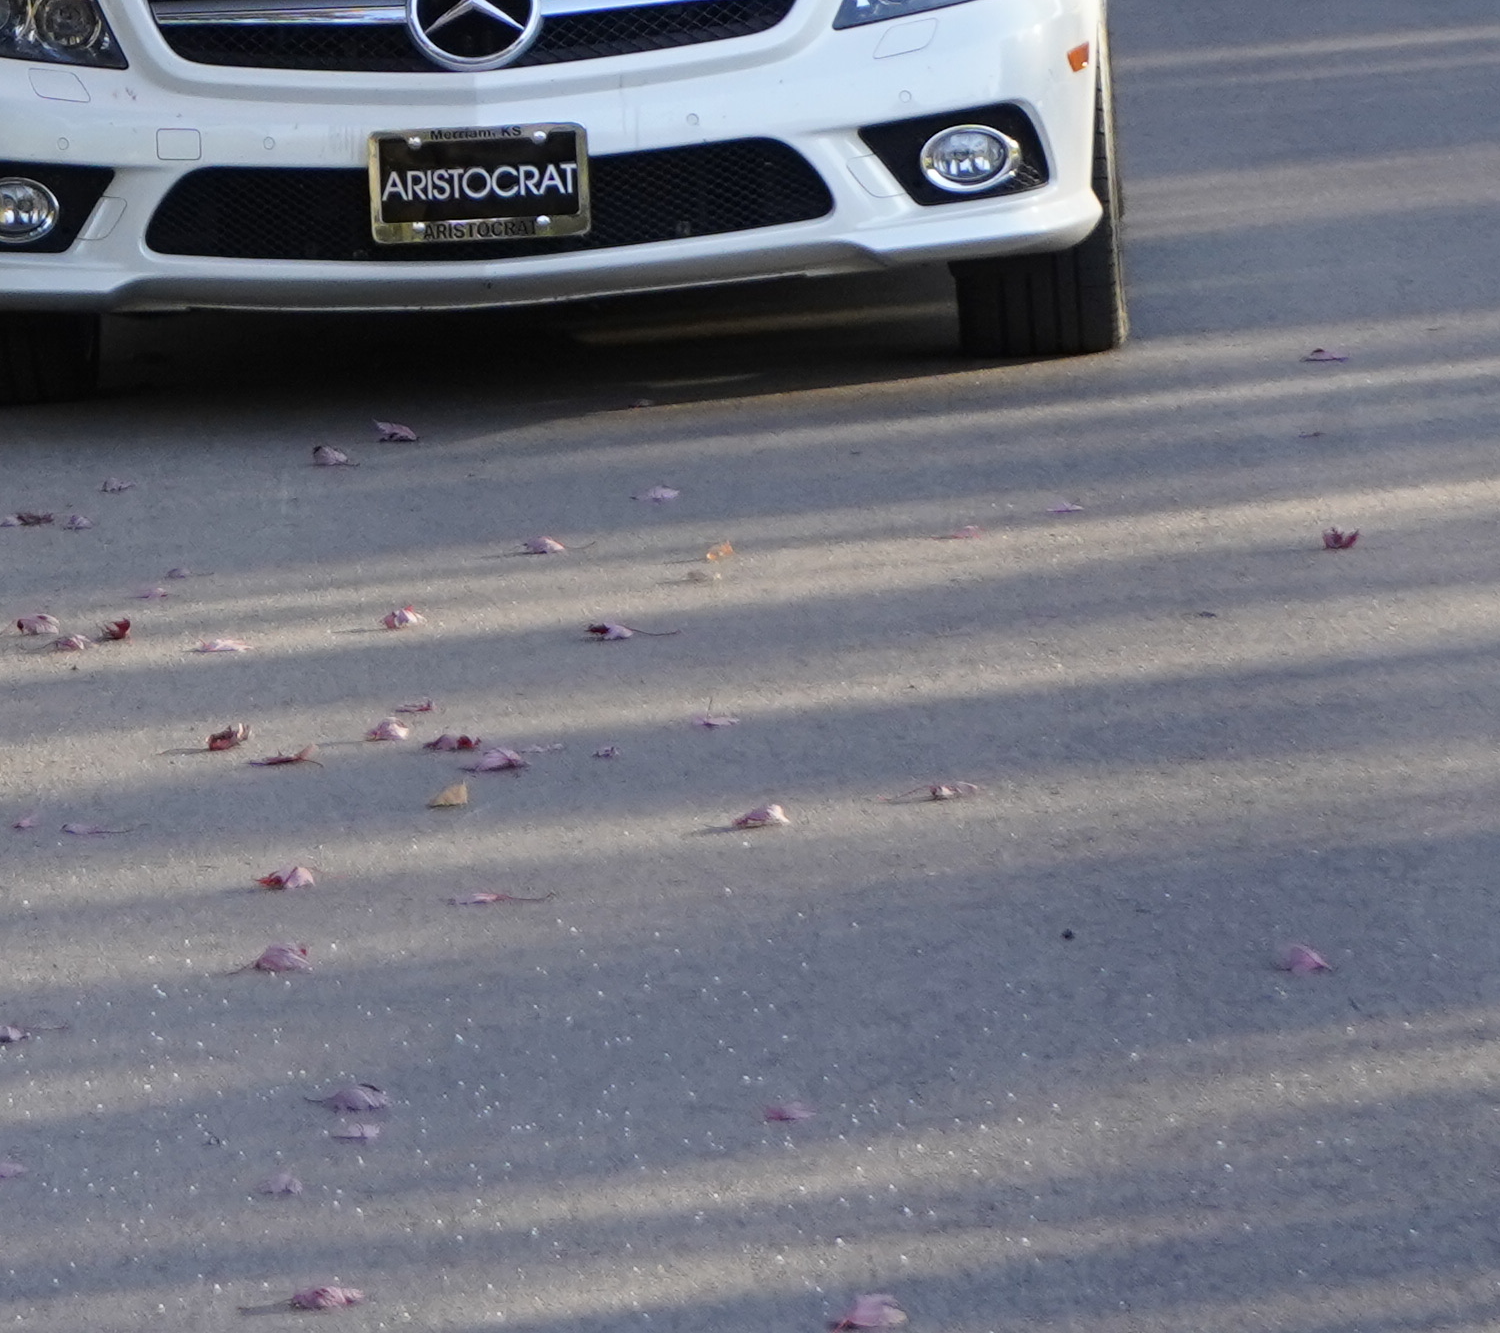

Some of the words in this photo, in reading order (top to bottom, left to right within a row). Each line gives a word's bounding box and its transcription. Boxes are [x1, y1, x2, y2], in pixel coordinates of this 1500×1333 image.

[501, 126, 522, 137] KS
[382, 163, 577, 201] ARISTOCRAT
[424, 220, 538, 241] ARISTOCRAT
